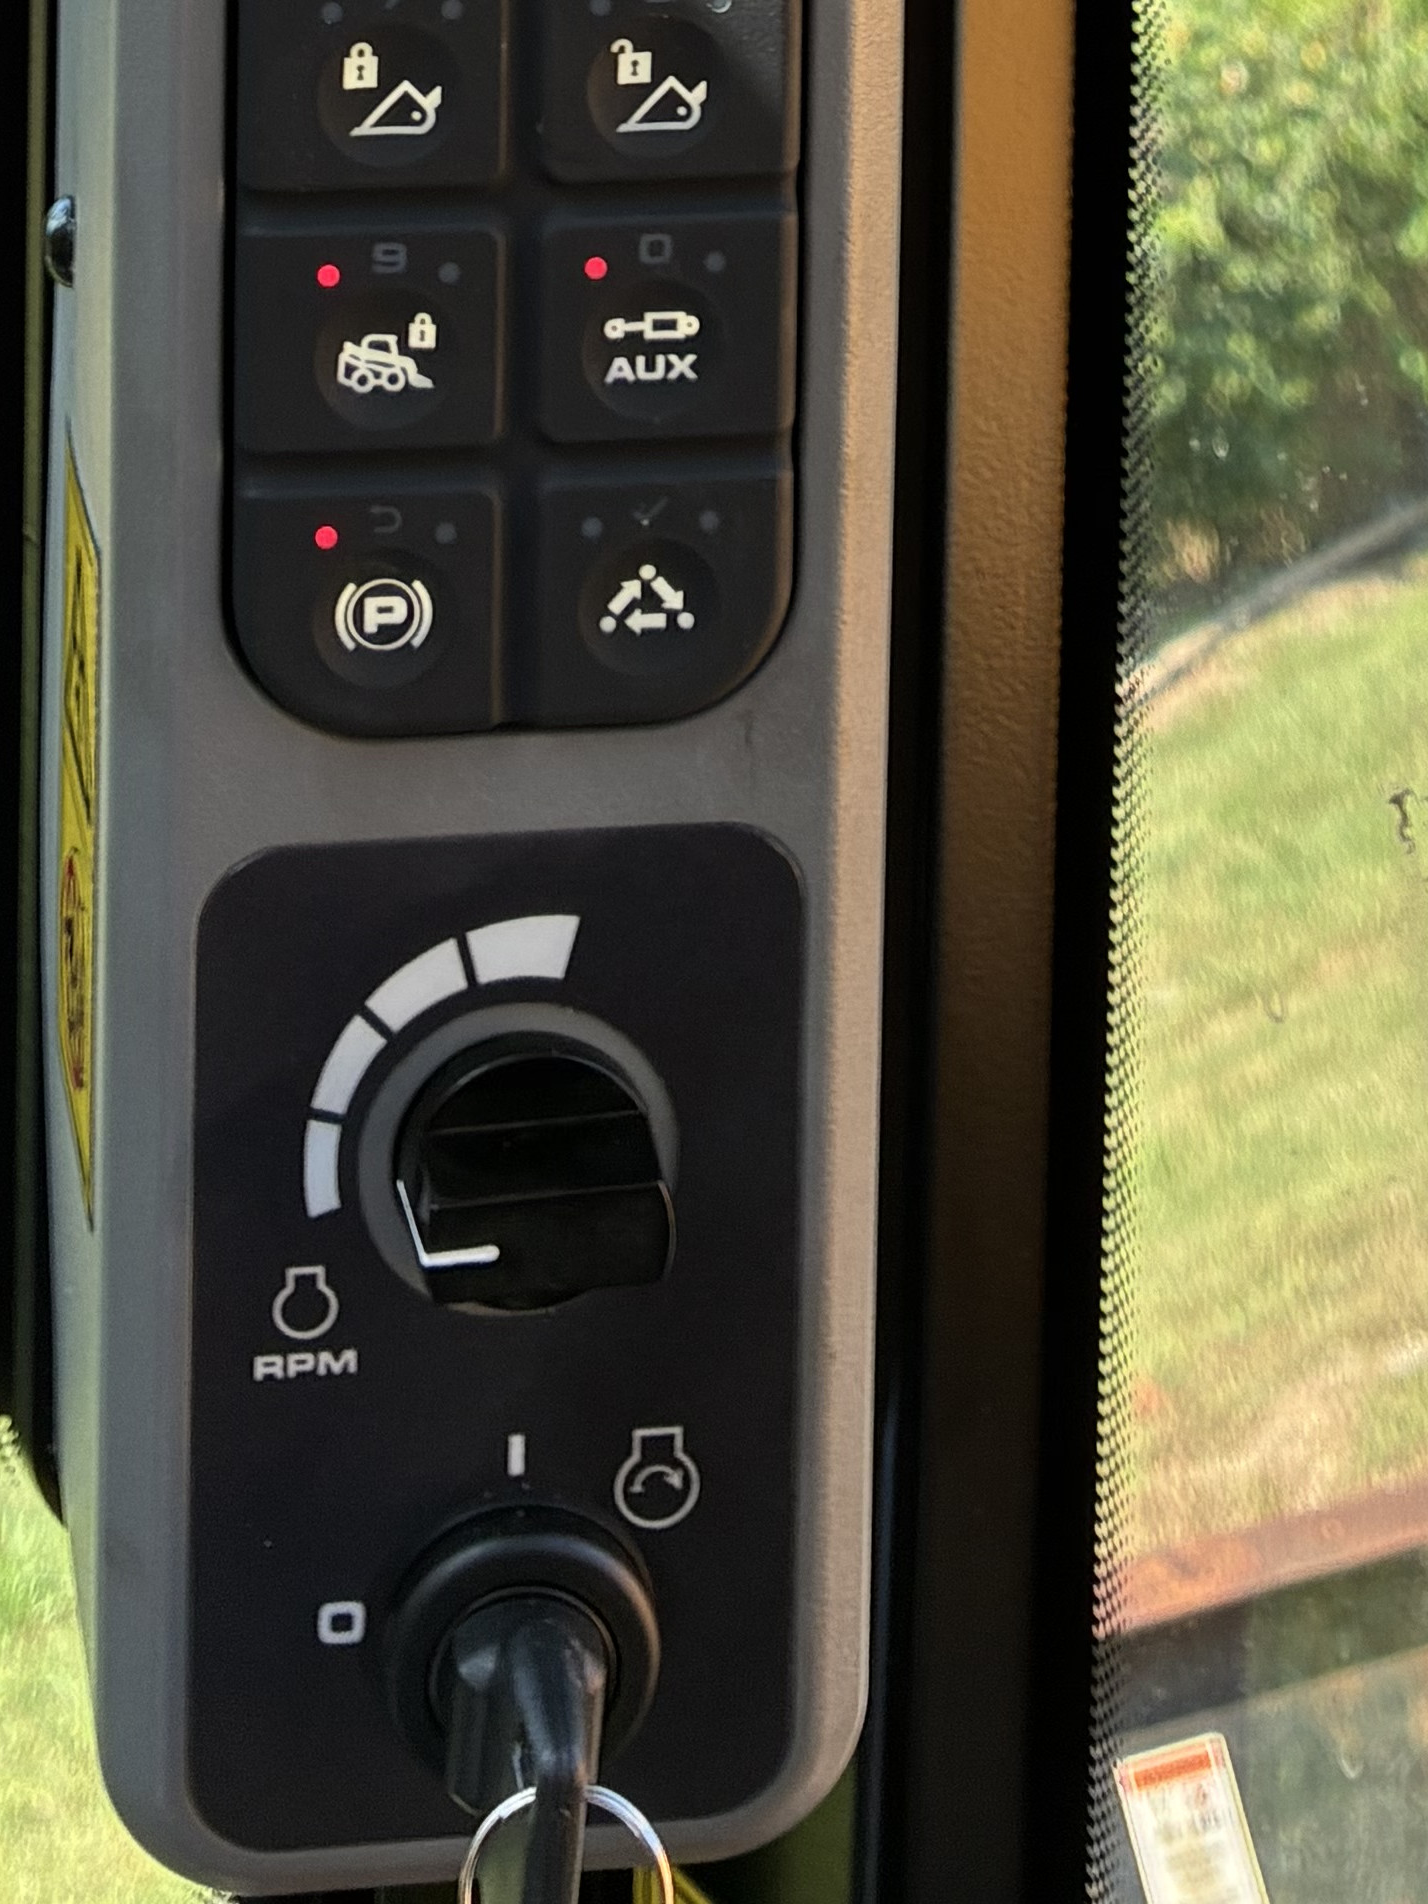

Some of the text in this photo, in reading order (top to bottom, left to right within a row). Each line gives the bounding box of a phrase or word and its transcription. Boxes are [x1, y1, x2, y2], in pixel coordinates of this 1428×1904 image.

[373, 242, 408, 274] 9
[604, 352, 699, 384] AUX
[363, 594, 408, 634] P
[252, 1349, 359, 1382] RPM
